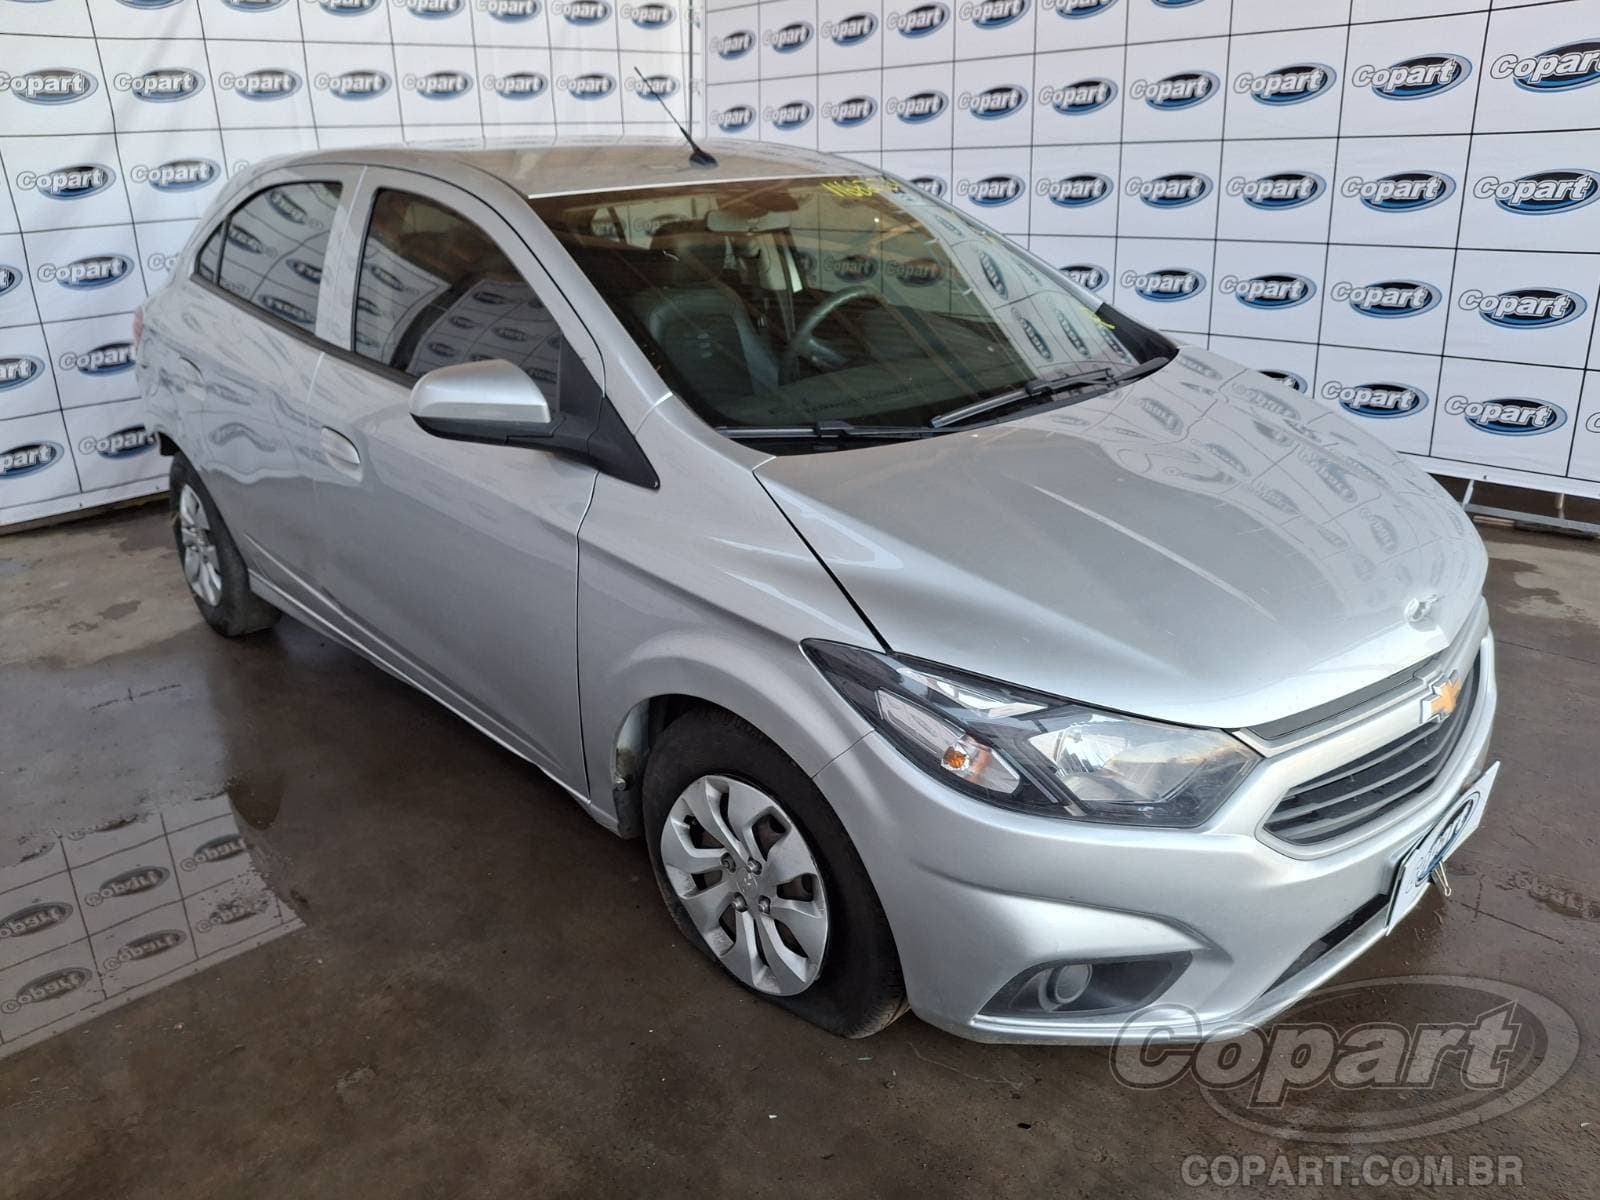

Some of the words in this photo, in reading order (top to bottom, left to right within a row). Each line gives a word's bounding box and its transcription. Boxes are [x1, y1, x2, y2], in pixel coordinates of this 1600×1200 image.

[552, 1, 605, 21] Copart
[621, 6, 669, 27] Copart
[887, 5, 944, 30] Copart
[959, 0, 1021, 23] Copart
[764, 25, 808, 47] Copart
[822, 17, 872, 39] Copart
[710, 33, 750, 54] Copart
[113, 71, 196, 96] Copart
[219, 72, 292, 93] Copart
[314, 72, 382, 93] Copart
[403, 73, 463, 93] Copart
[483, 75, 543, 95] Copart
[557, 75, 610, 94] Copart
[1234, 68, 1324, 98] Copart
[1352, 58, 1456, 93] Copart
[958, 87, 1020, 112] Copart
[1039, 82, 1109, 108] Copart
[1130, 76, 1210, 103] Copart
[710, 107, 750, 128] Copart
[763, 104, 808, 124] Copart
[822, 99, 872, 121] Copart
[887, 96, 943, 119] Copart
[17, 166, 105, 191] Copart
[130, 161, 210, 187] Copart
[957, 178, 1019, 202] Copart
[1036, 177, 1102, 201] Copart
[1125, 176, 1203, 201] Copart
[1226, 175, 1313, 202] Copart
[1341, 175, 1444, 204] Copart
[1474, 174, 1592, 205] Copart
[37, 256, 123, 285] Copart
[1121, 270, 1196, 293] Copart
[1220, 275, 1305, 300] Copart
[1331, 281, 1428, 309] Copart
[1459, 289, 1570, 318] Copart
[1322, 381, 1417, 410] Copart
[1445, 395, 1552, 427] Copart
[0, 445, 49, 474] part
